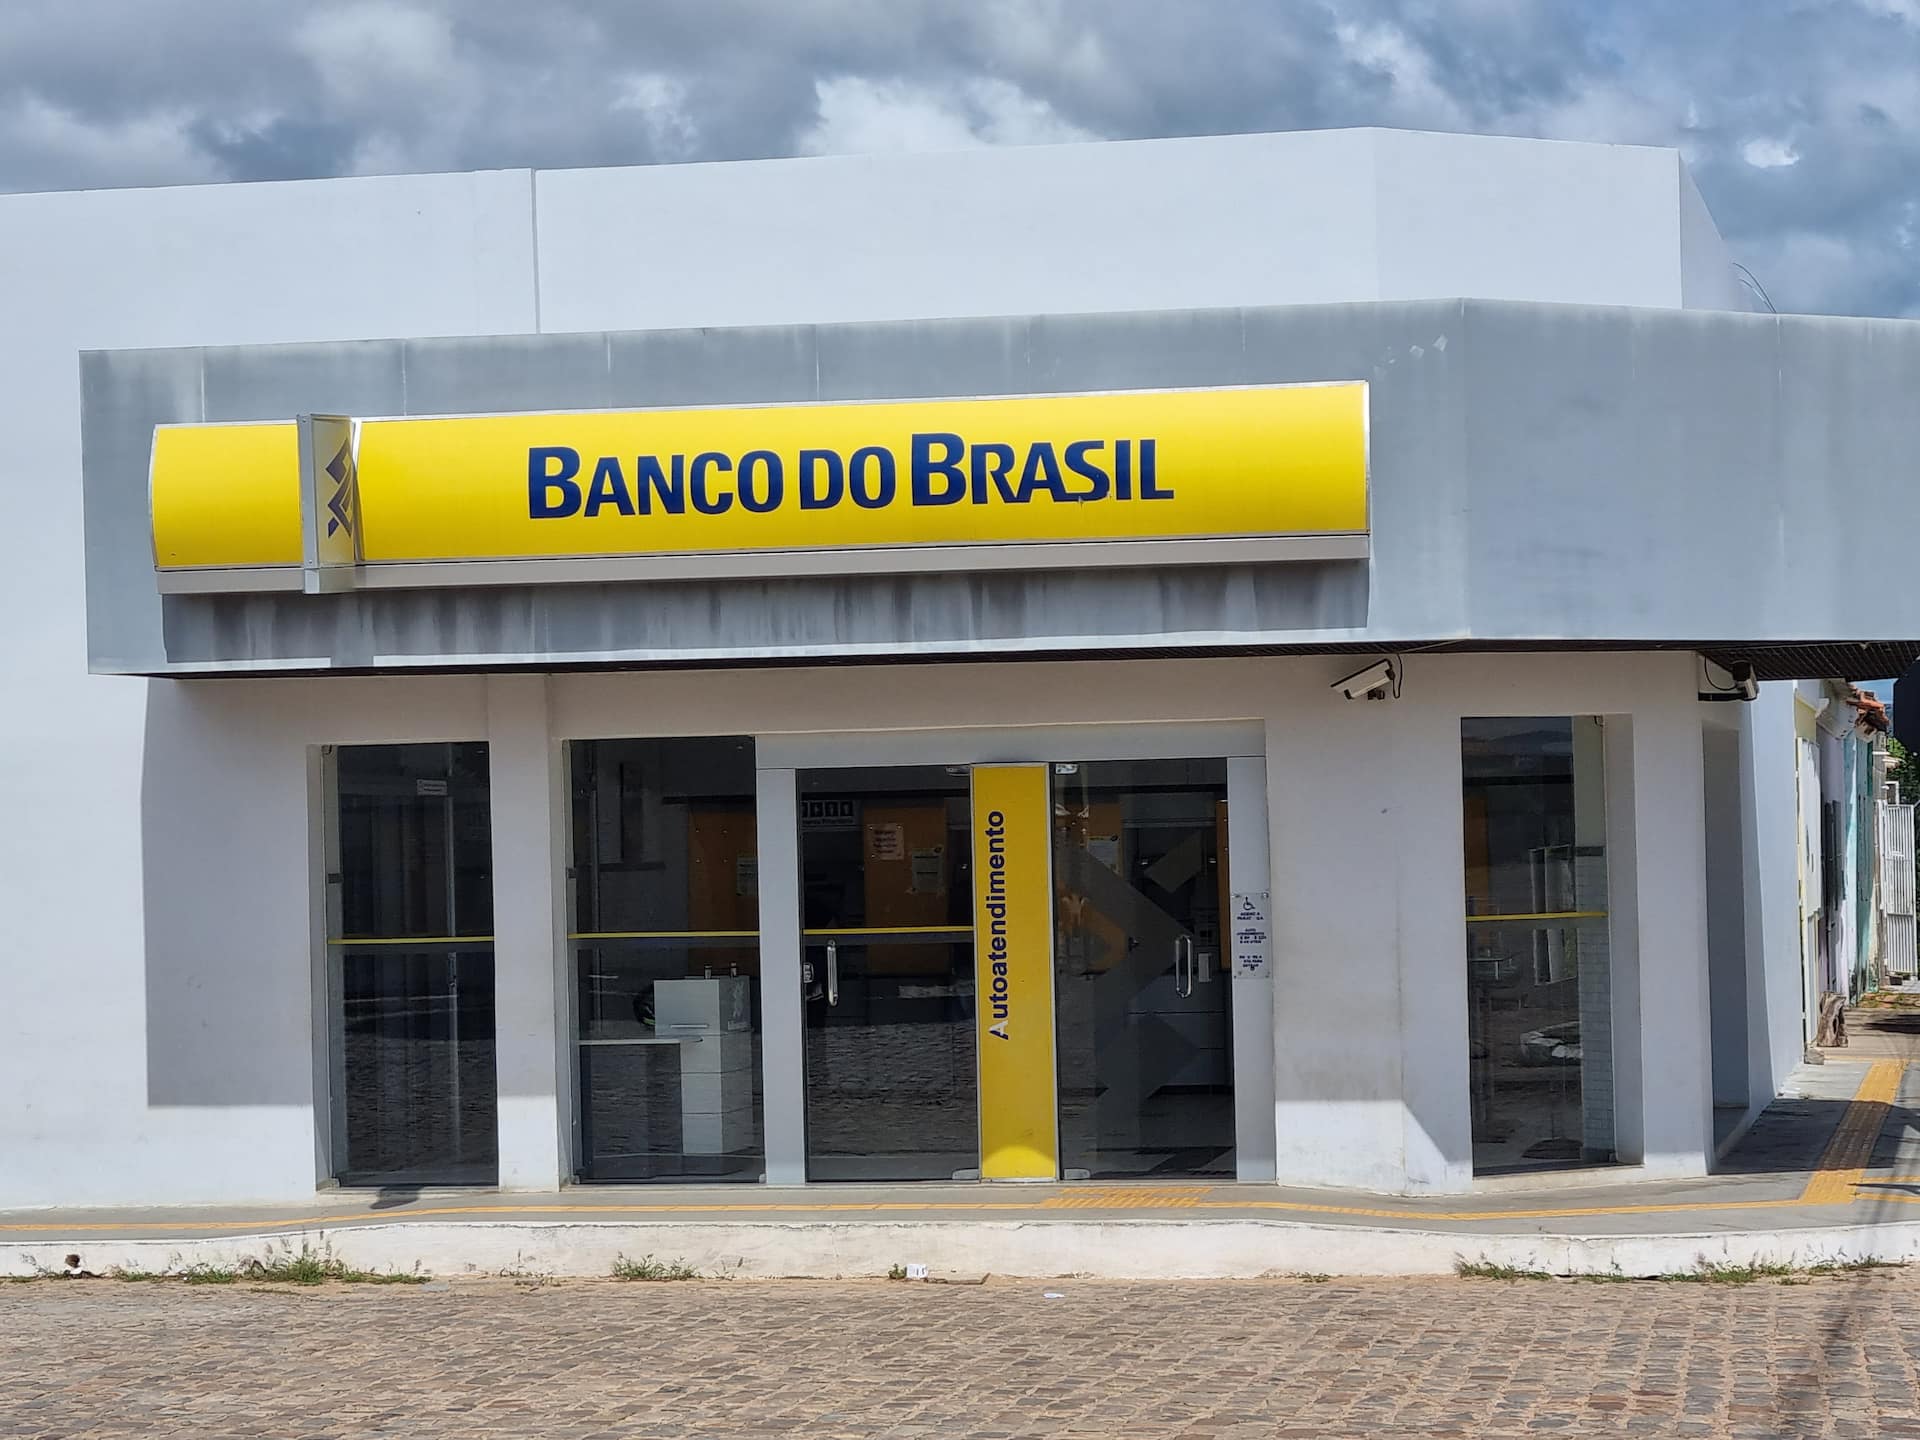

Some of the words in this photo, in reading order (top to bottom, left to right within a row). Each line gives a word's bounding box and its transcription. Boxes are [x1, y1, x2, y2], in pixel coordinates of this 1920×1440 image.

[528, 446, 783, 519] BANCO
[799, 446, 896, 510] DO
[911, 432, 1174, 507] BRASIL
[986, 811, 1009, 1040] Autoatendimento
